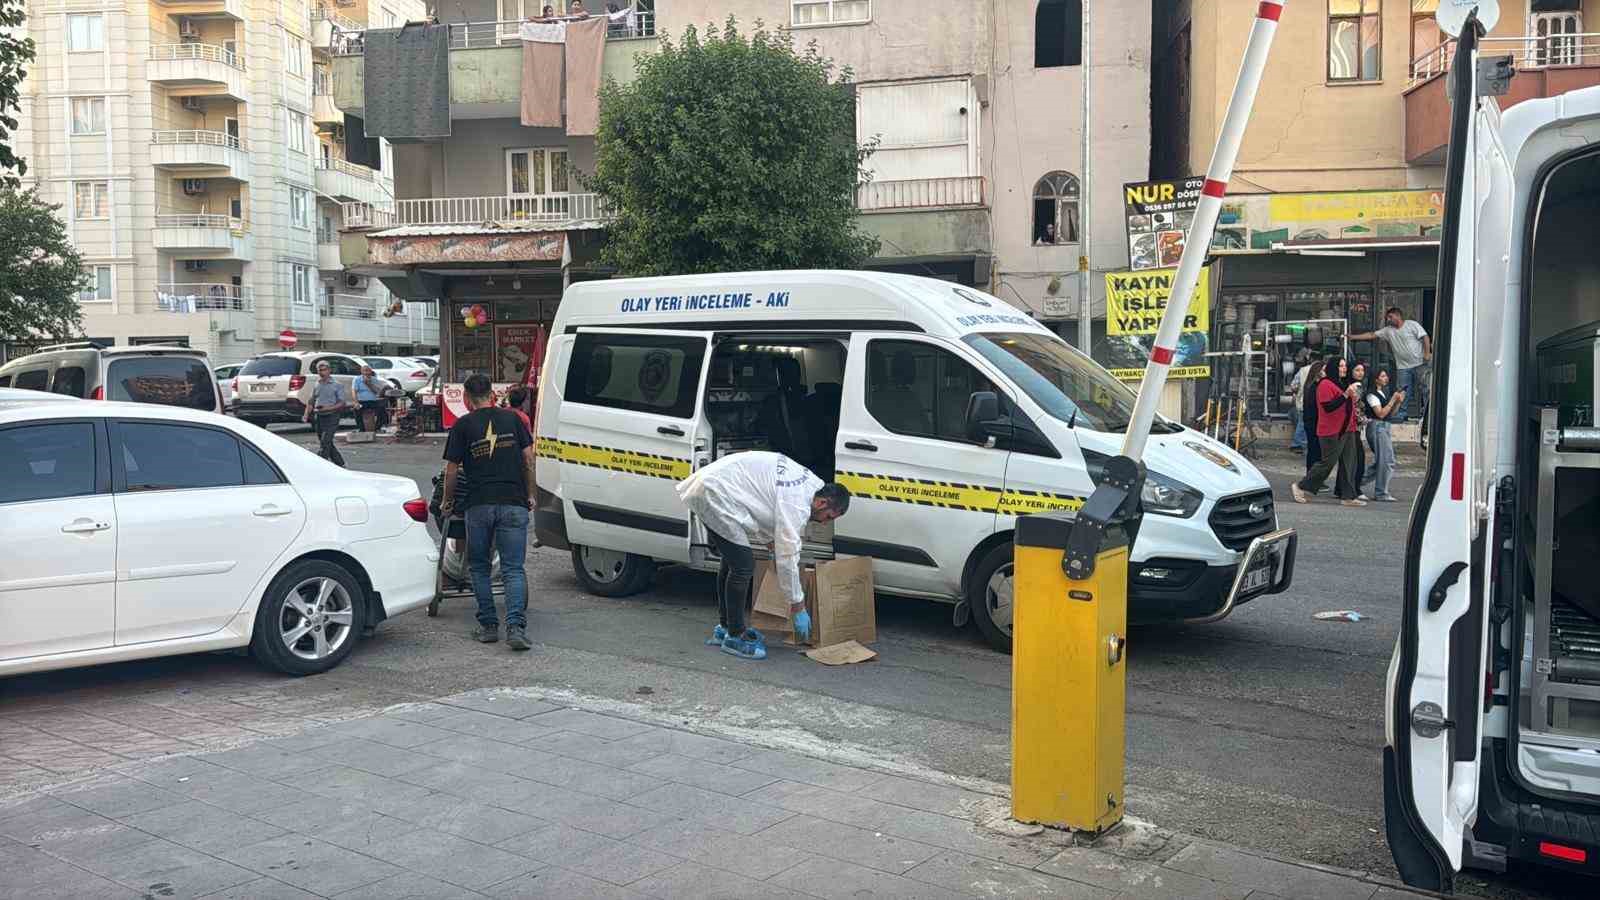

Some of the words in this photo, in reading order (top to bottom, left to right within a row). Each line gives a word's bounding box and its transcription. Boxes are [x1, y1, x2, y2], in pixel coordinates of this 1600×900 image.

[1185, 180, 1203, 188] OTO
[1127, 184, 1174, 204] NUR
[1177, 190, 1200, 199] DÖŞE
[1115, 275, 1169, 290] KAYN
[621, 298, 651, 312] OLAY
[1123, 292, 1168, 313] İŞLE
[1117, 315, 1197, 331] YAPIR
[611, 455, 627, 464] OLAY
[880, 483, 899, 493] OLAY
[999, 497, 1024, 506] OLAY
